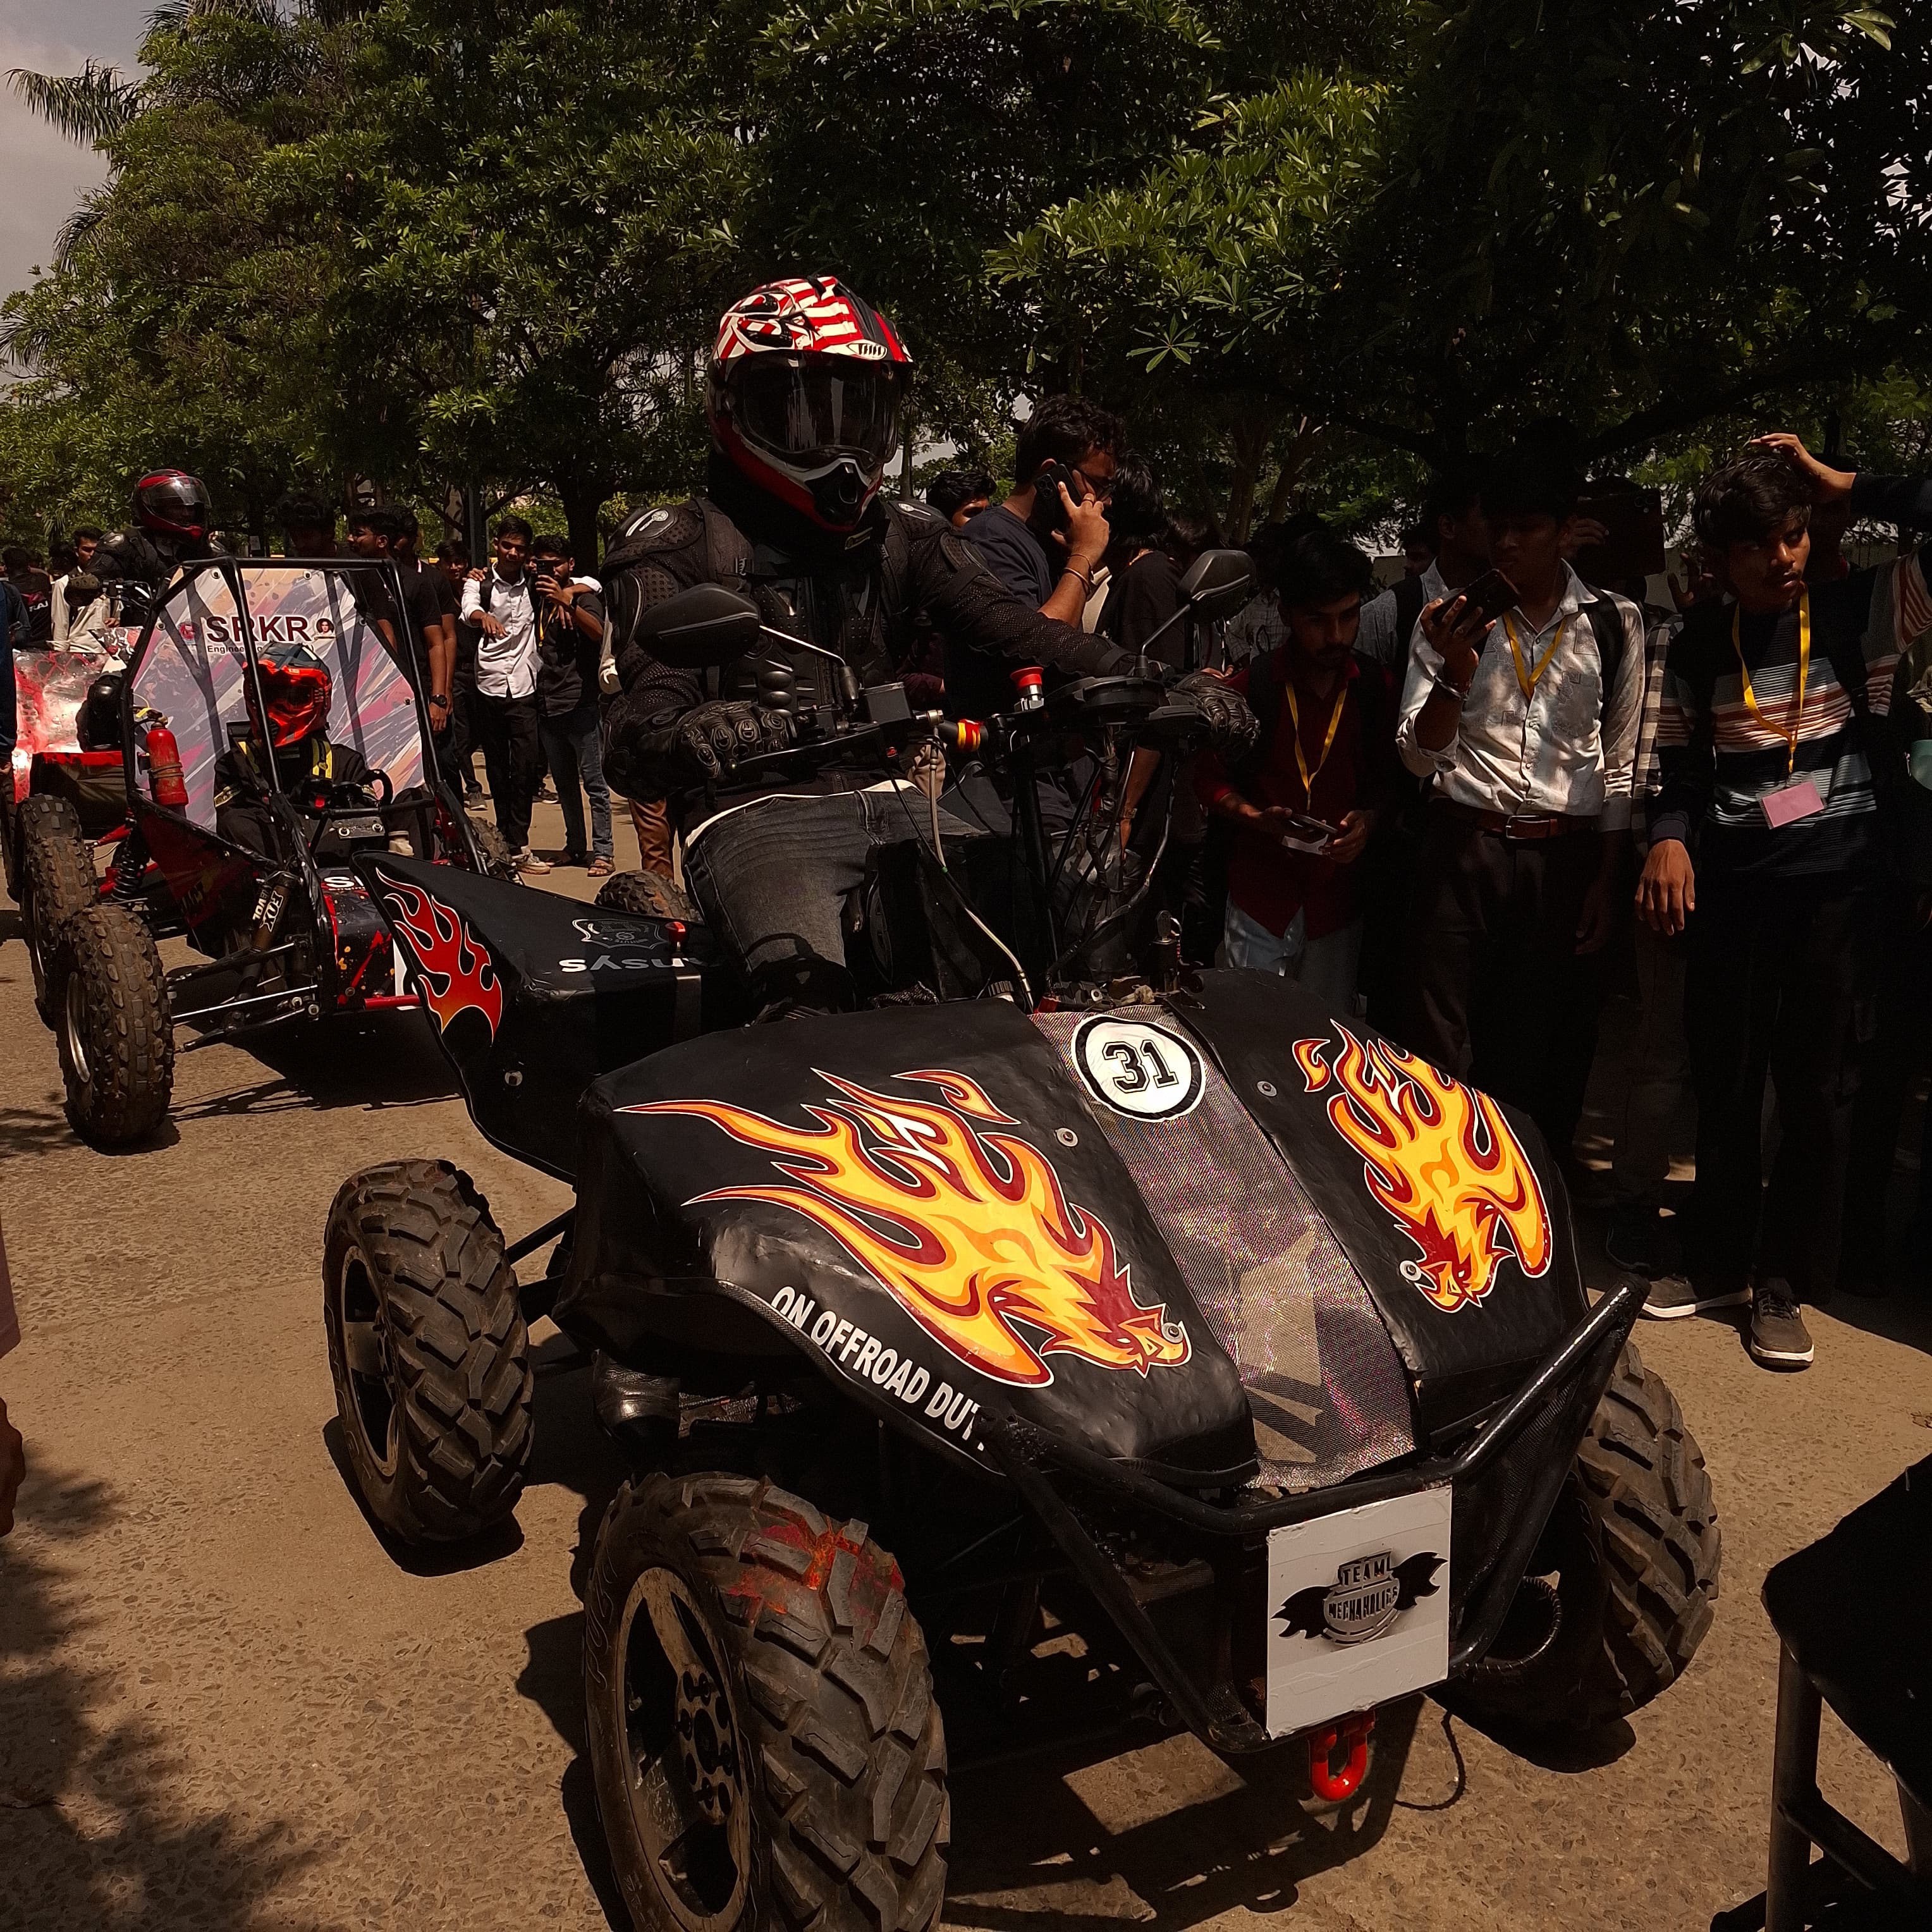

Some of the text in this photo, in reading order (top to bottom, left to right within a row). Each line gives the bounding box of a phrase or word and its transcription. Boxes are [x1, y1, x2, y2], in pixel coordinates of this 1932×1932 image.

[207, 616, 312, 642] SRKR
[259, 890, 284, 932] FOX
[1102, 1039, 1179, 1094] 31
[771, 1286, 985, 1452] ON OFFROAD DUT
[1343, 1558, 1385, 1586] TEAM
